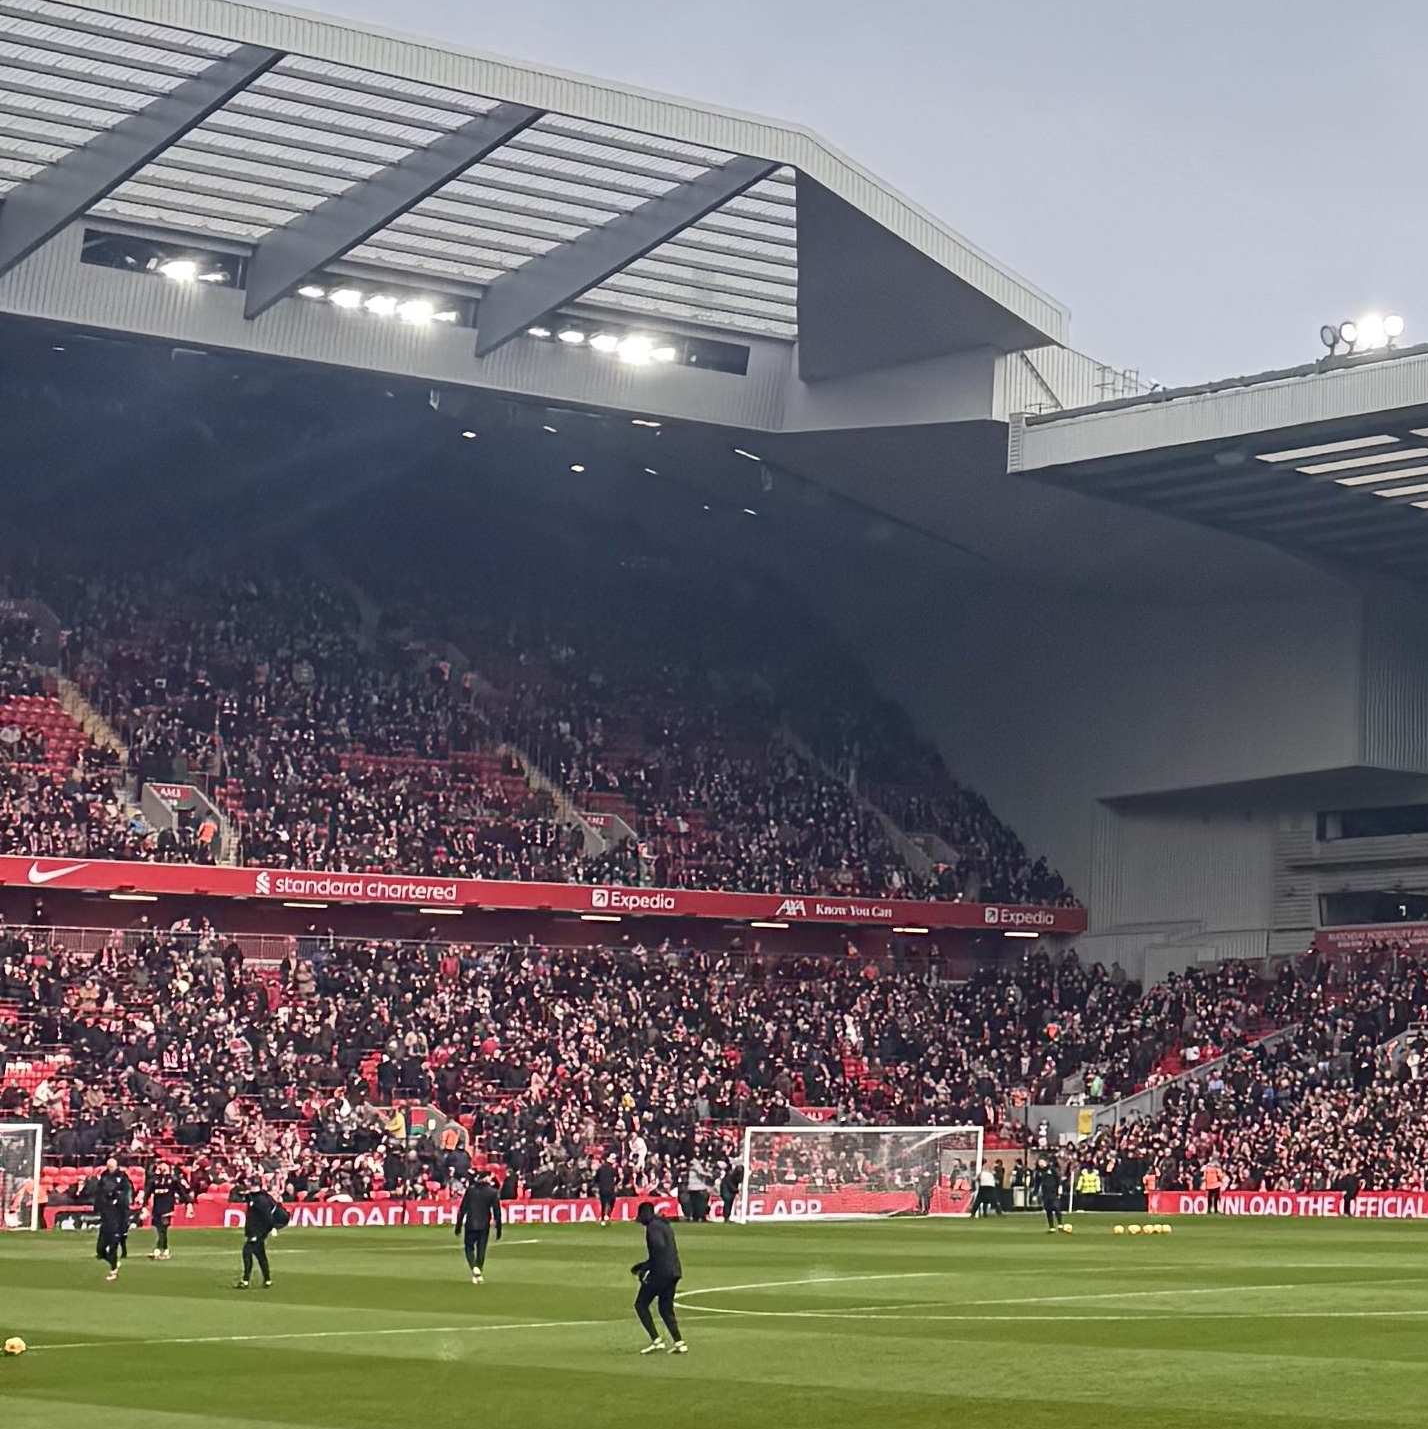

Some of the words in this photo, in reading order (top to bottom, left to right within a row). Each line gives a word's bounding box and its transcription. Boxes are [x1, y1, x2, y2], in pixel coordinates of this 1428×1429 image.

[275, 876, 363, 896] standard
[366, 882, 457, 901] chartered
[610, 891, 675, 910] Expedia
[775, 899, 807, 917] AXA
[815, 903, 847, 915] Know
[849, 905, 870, 917] You
[871, 906, 893, 918] Can
[1000, 908, 1055, 926] Expedia
[223, 1206, 410, 1228] DNLOAD
[416, 1205, 460, 1226] TH
[501, 1202, 602, 1223] FFICIA
[773, 1200, 823, 1215] APP
[1296, 1196, 1339, 1217] THE
